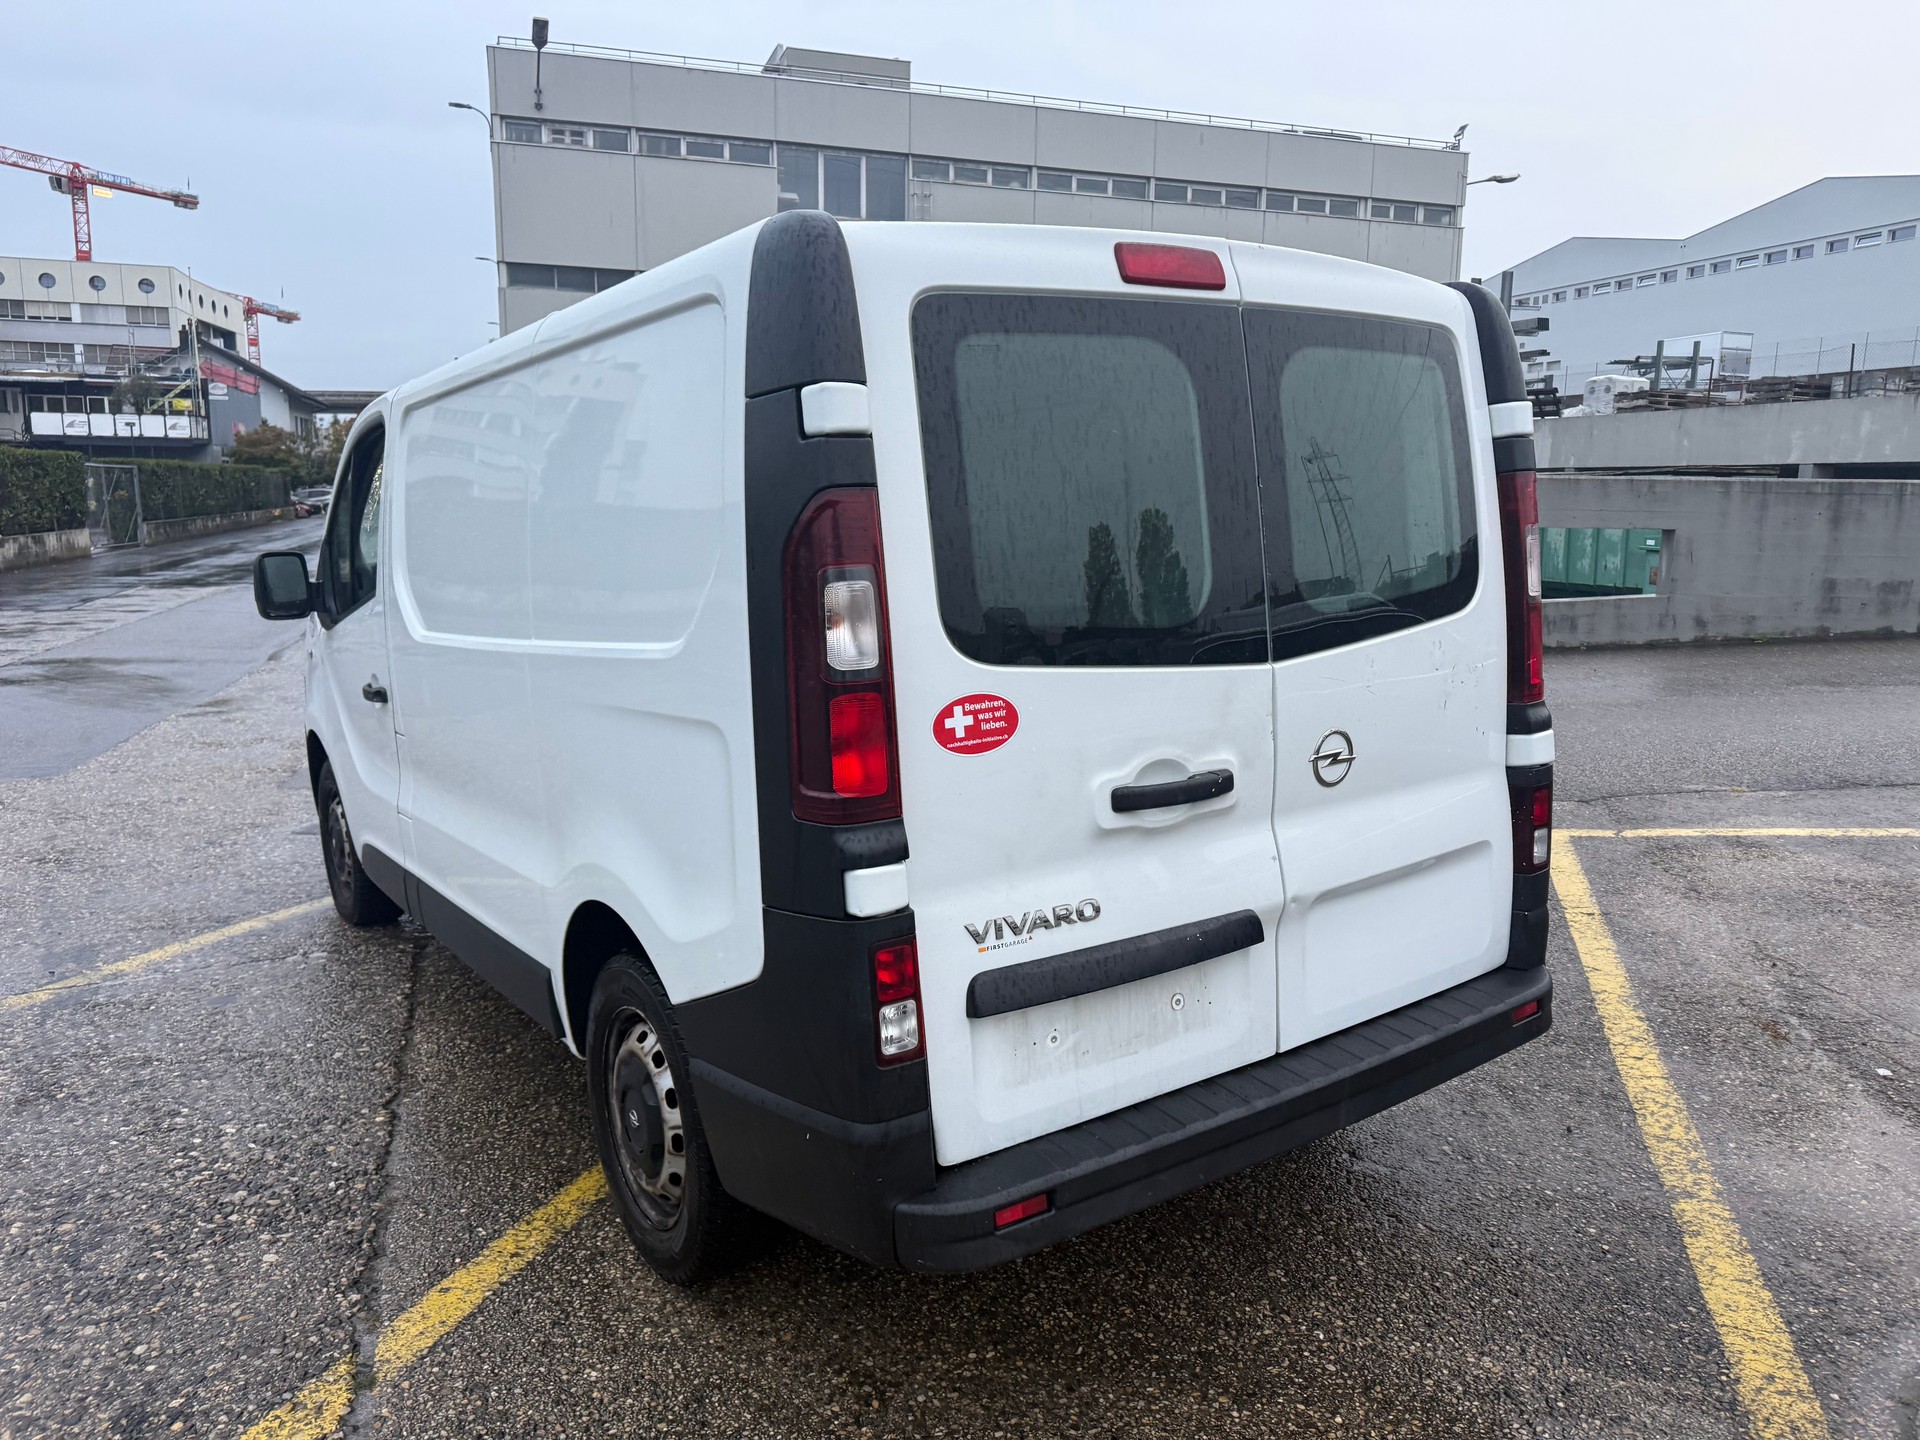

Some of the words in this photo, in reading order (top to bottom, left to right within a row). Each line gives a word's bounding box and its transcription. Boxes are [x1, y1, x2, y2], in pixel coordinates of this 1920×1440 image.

[964, 700, 1006, 711] Bewahren,
[977, 711, 993, 720] was
[994, 708, 1007, 717] wir
[980, 720, 1008, 730] lieben.
[963, 898, 1101, 945] VIVARO
[986, 938, 1028, 951] FIRSTGARAGE
